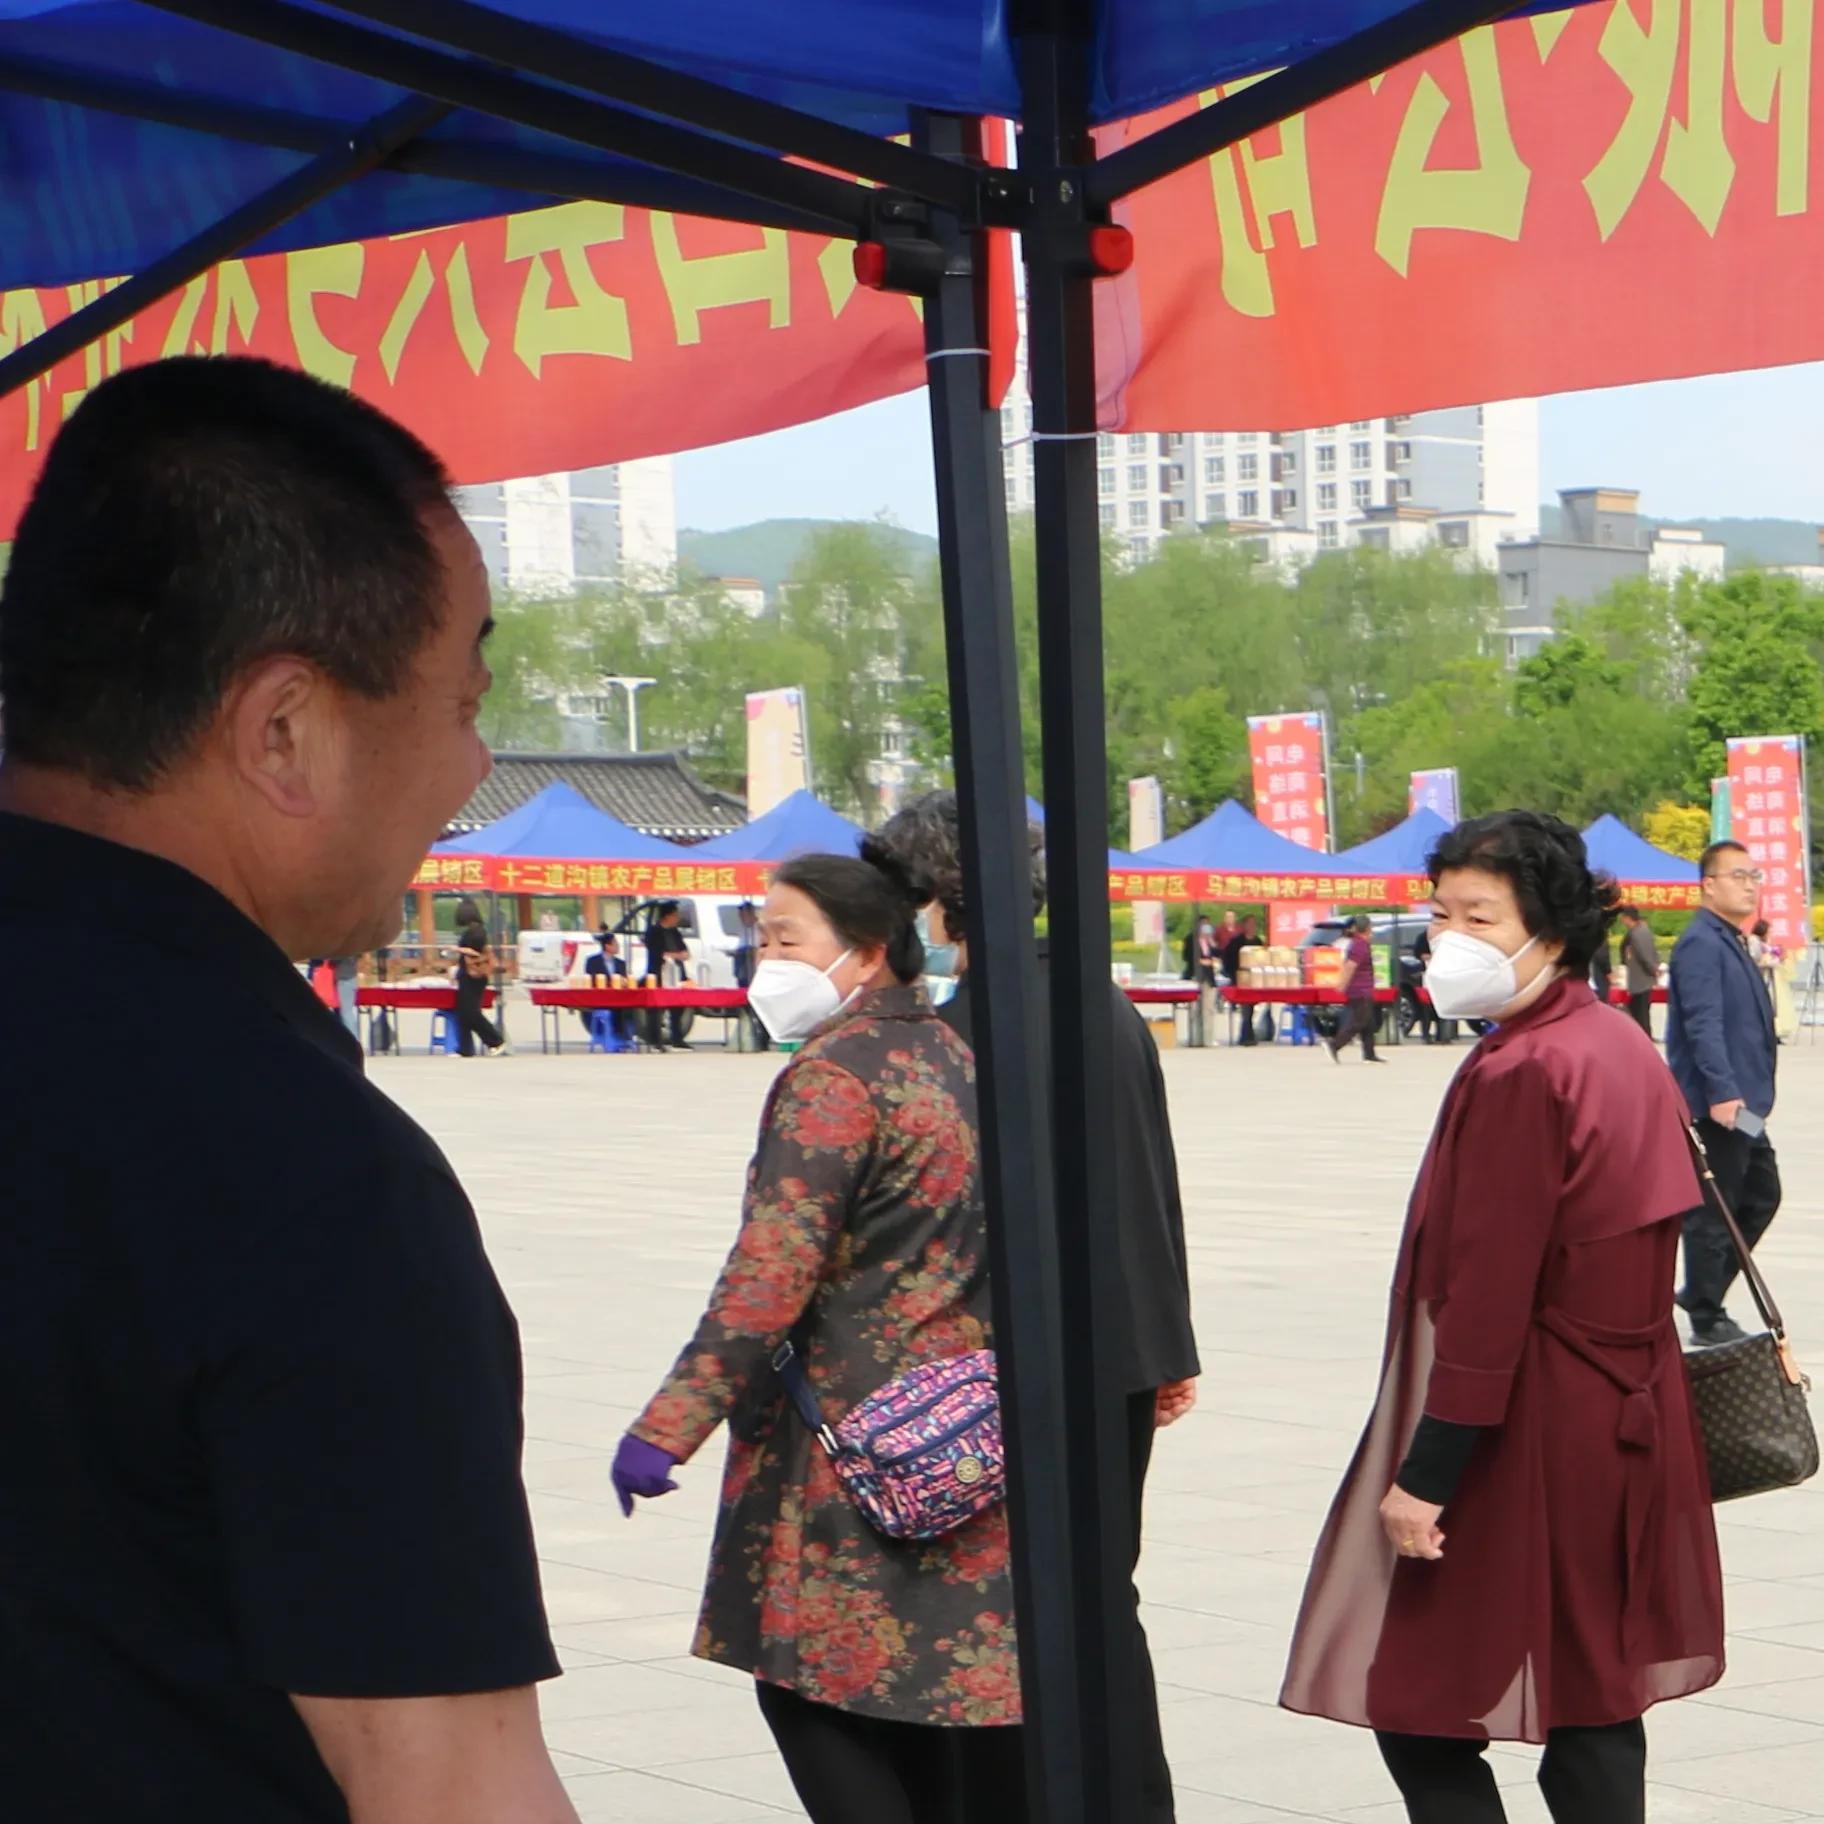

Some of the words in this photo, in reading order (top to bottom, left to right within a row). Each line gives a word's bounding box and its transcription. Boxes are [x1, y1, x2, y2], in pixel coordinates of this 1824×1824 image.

[500, 863, 738, 891] 十二道沟镇农产品展销区
